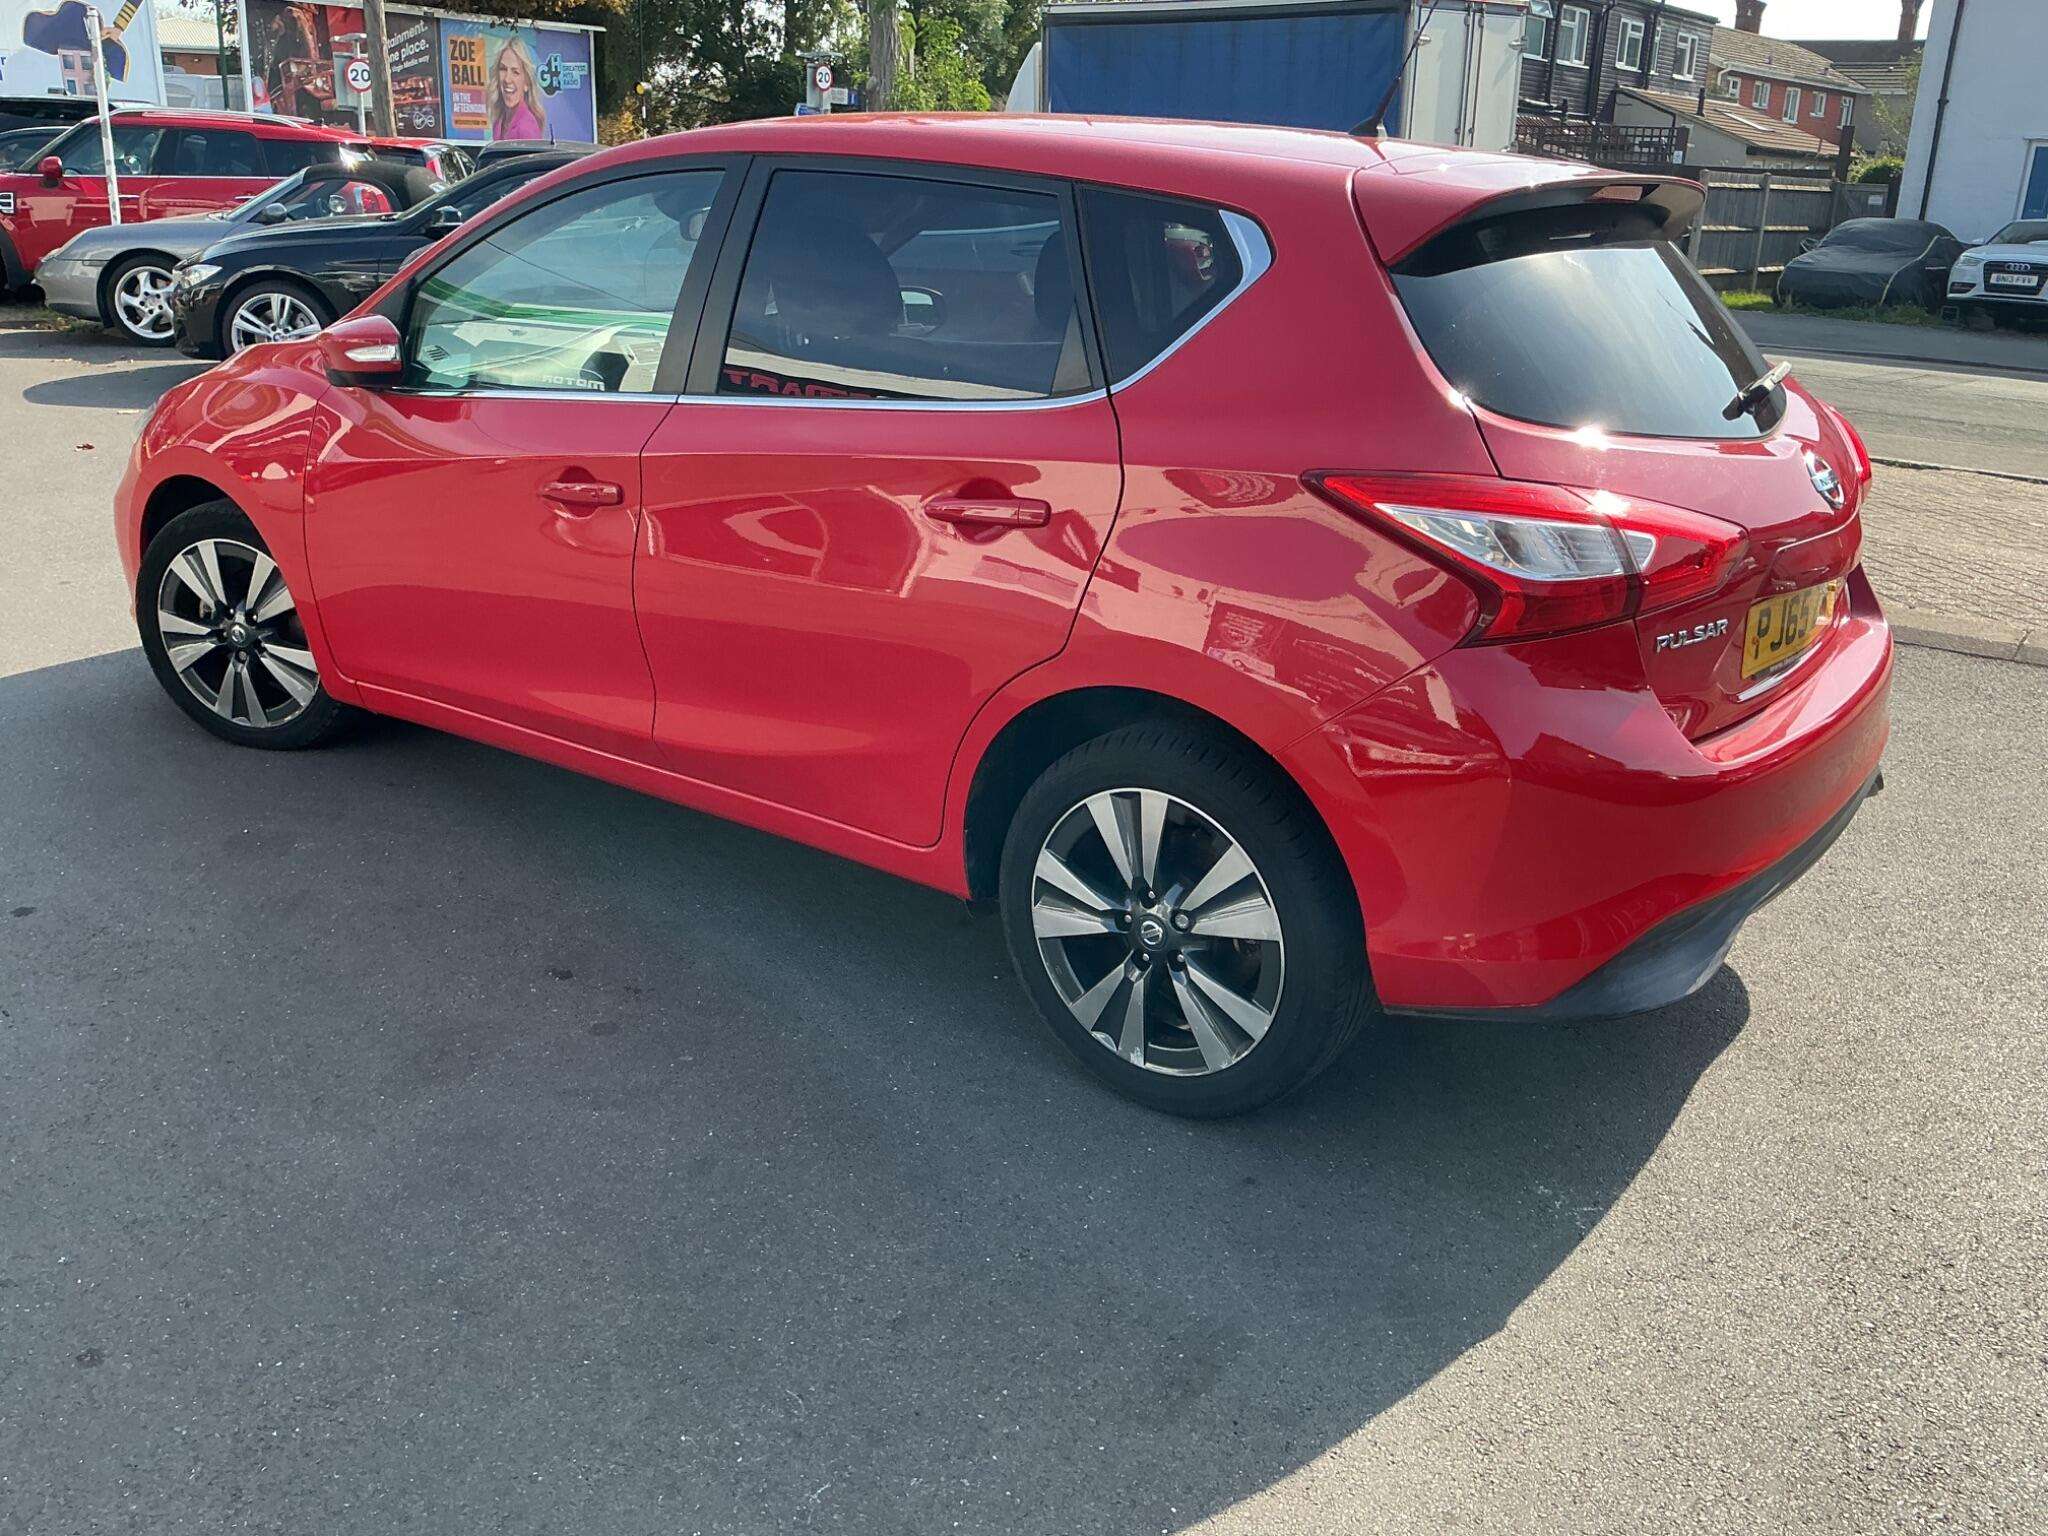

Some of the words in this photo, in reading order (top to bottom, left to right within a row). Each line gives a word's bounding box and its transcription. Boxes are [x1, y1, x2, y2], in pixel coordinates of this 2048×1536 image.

[401, 39, 430, 61] place.
[450, 39, 475, 61] ZOE
[350, 69, 371, 82] 20
[451, 64, 485, 87] BALL
[818, 71, 831, 84] 20
[1656, 619, 1728, 654] PULSAR
